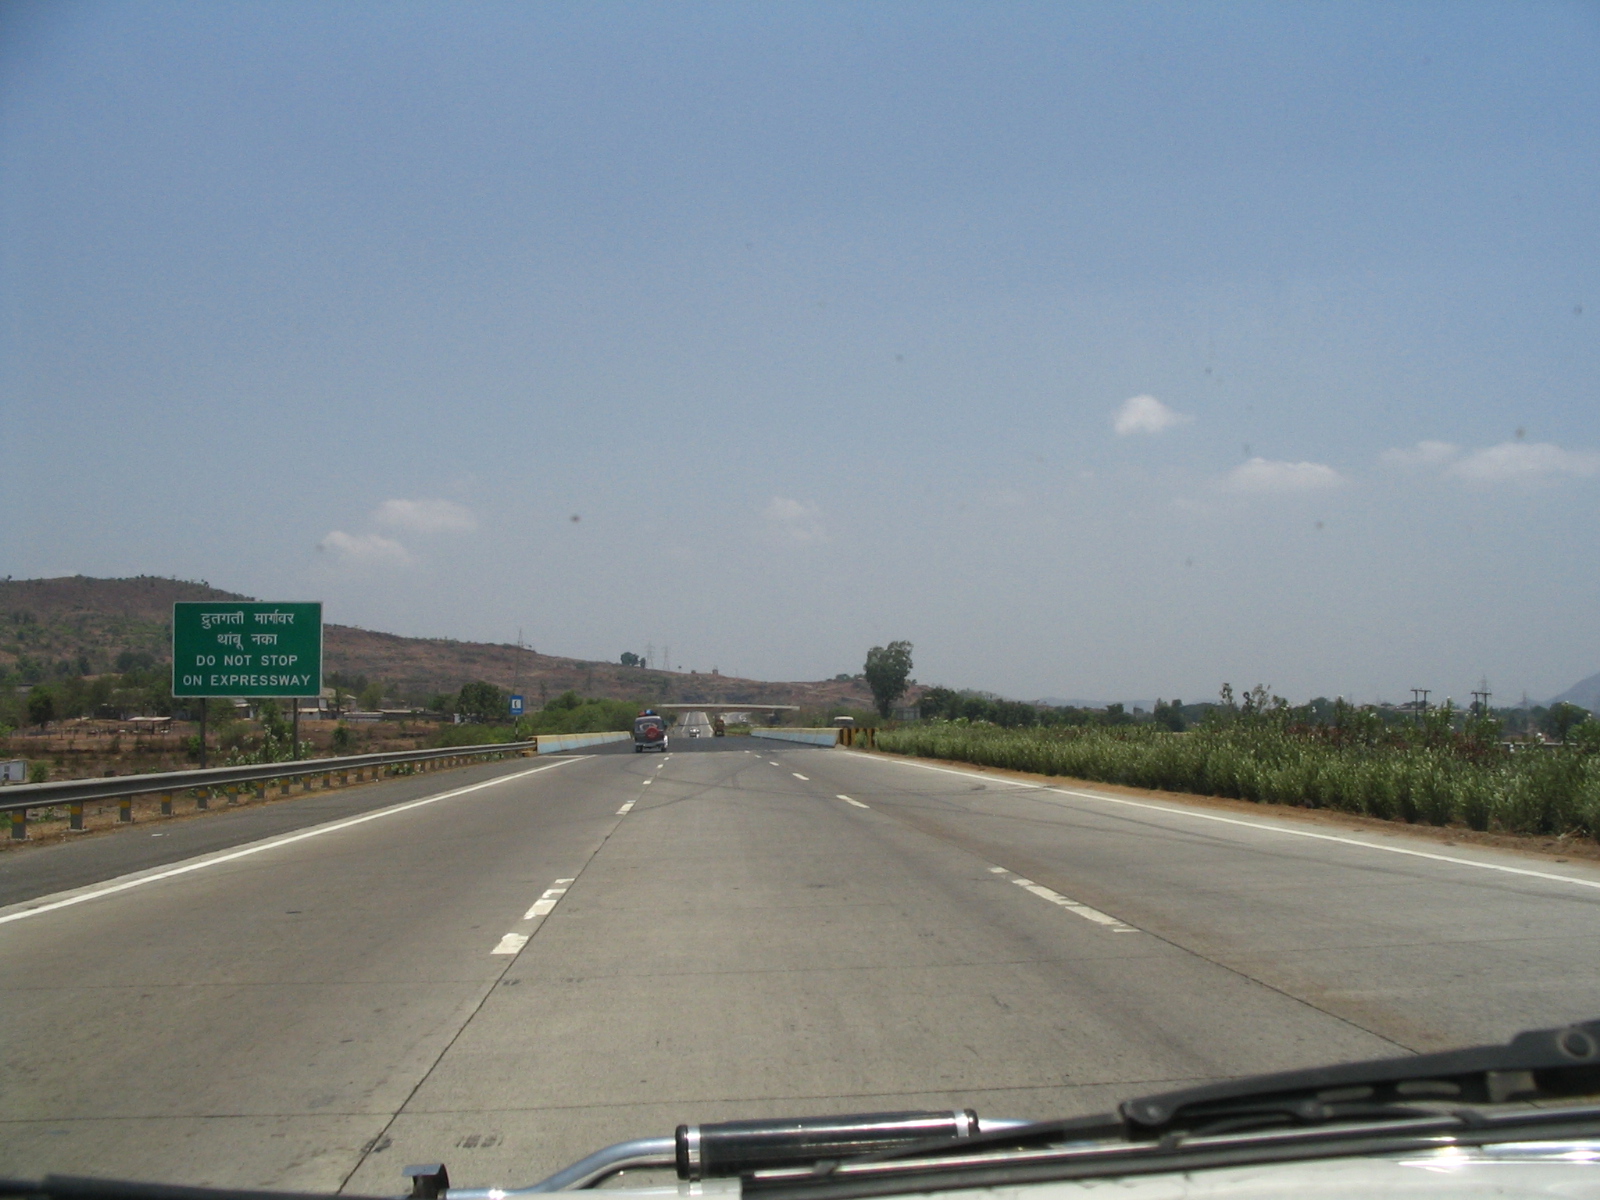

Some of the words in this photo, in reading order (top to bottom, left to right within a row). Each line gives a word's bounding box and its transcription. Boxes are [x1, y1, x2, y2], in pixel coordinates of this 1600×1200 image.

[250, 633, 278, 645] नका
[196, 655, 216, 666] DO
[224, 655, 252, 666] NOT
[261, 655, 298, 666] STOP
[183, 675, 202, 686] ON
[210, 675, 311, 686] EXPRESSWAY
